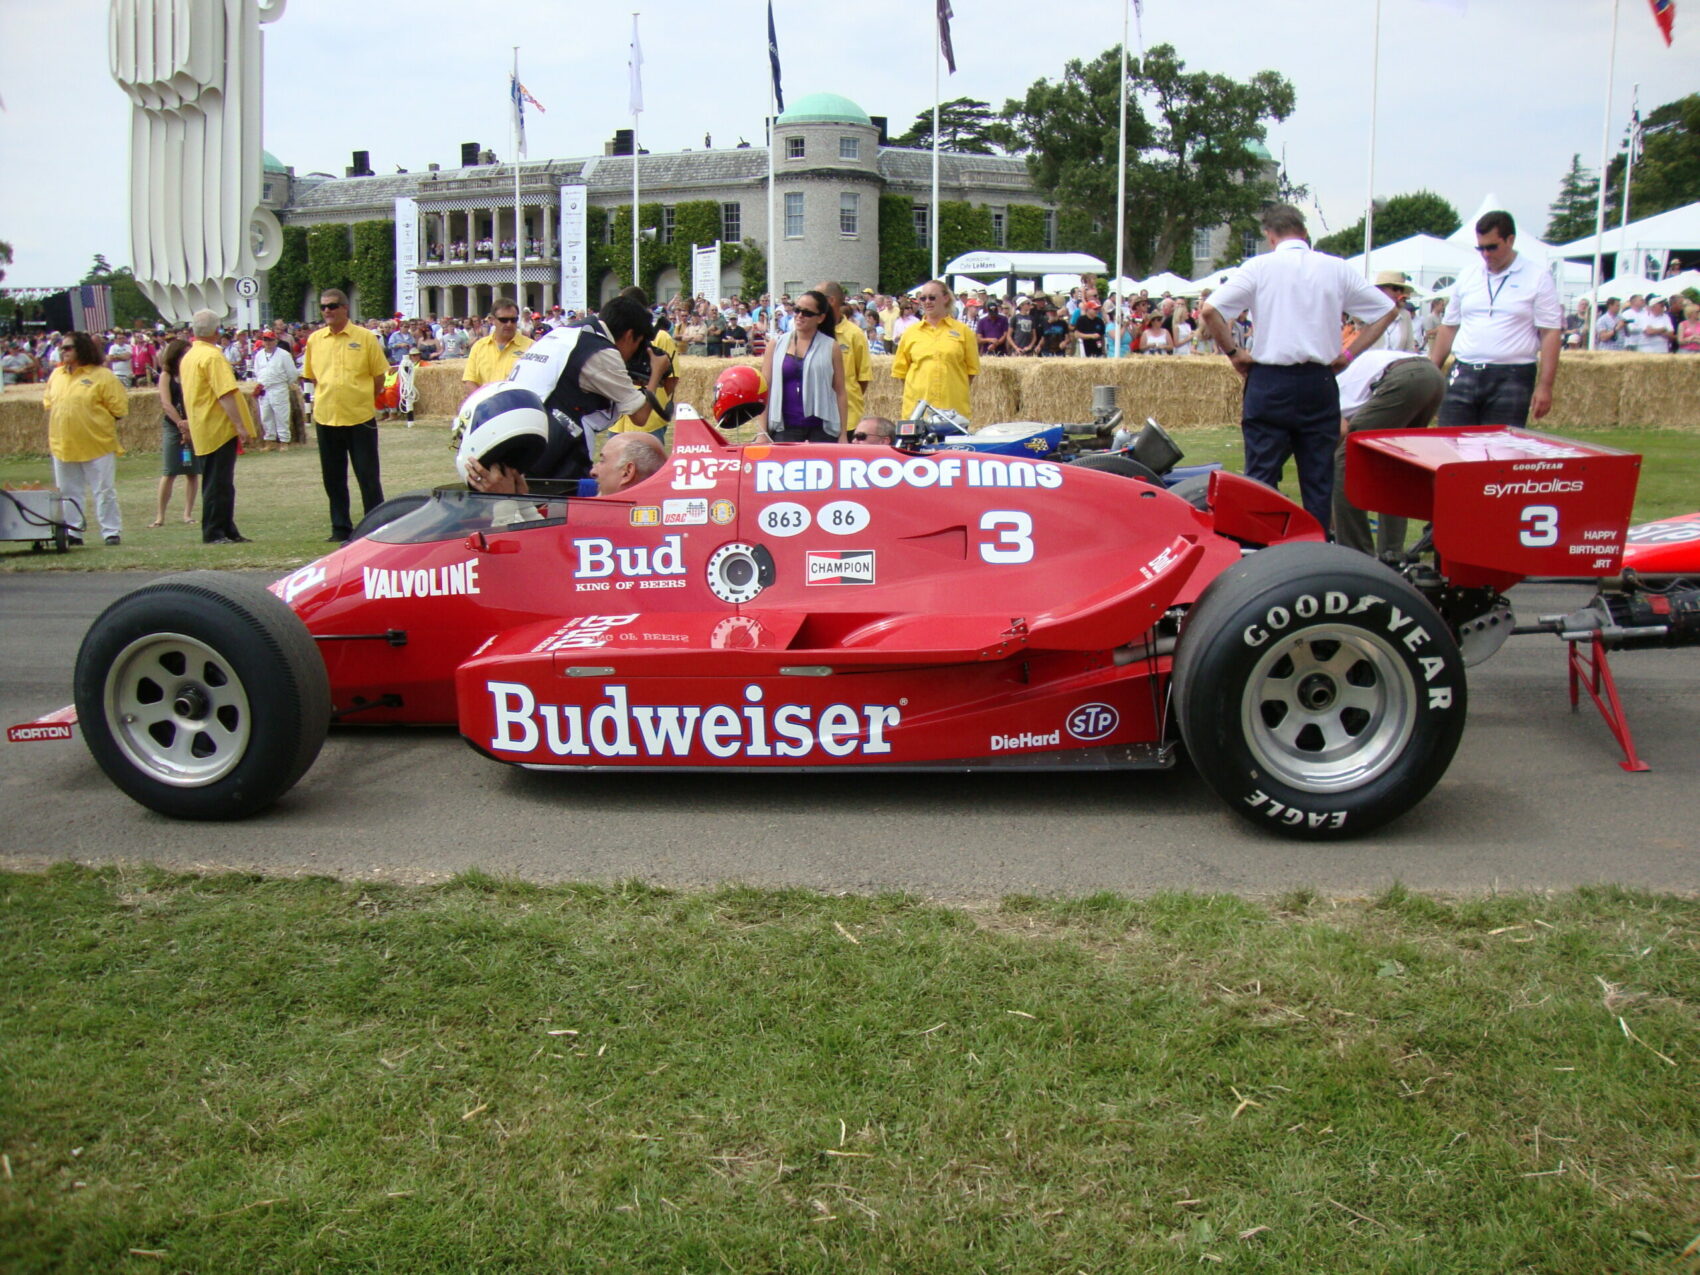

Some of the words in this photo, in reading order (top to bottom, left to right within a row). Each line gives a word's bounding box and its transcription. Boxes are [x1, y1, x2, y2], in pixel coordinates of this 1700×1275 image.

[243, 281, 251, 294] 5
[676, 445, 713, 454] RAHAL
[718, 459, 741, 471] 73
[1512, 461, 1564, 472] GOODYEAR
[755, 460, 833, 493] RED
[838, 458, 961, 490] ROOF
[1483, 478, 1584, 498] symbolics
[664, 513, 687, 523] USAC
[768, 511, 802, 528] 863
[832, 509, 855, 526] 86
[1519, 504, 1560, 548] 3
[979, 510, 1035, 564] 3
[1584, 530, 1617, 540] HAPPY
[572, 534, 687, 578] Bud
[1569, 545, 1619, 555] BIRTHDAY!
[810, 561, 870, 574] CHAMPION
[1592, 559, 1612, 568] JRT
[363, 557, 481, 600] VALVOLINE
[575, 580, 611, 592] KING
[616, 581, 634, 590] OF
[639, 579, 687, 589] BEERS
[1243, 590, 1453, 711] GOODYEAR
[487, 681, 901, 757] Budweiser
[1072, 707, 1112, 733] STP
[11, 726, 70, 740] HORTON
[990, 730, 1060, 751] DieHard
[1244, 788, 1348, 830] EAGLE
